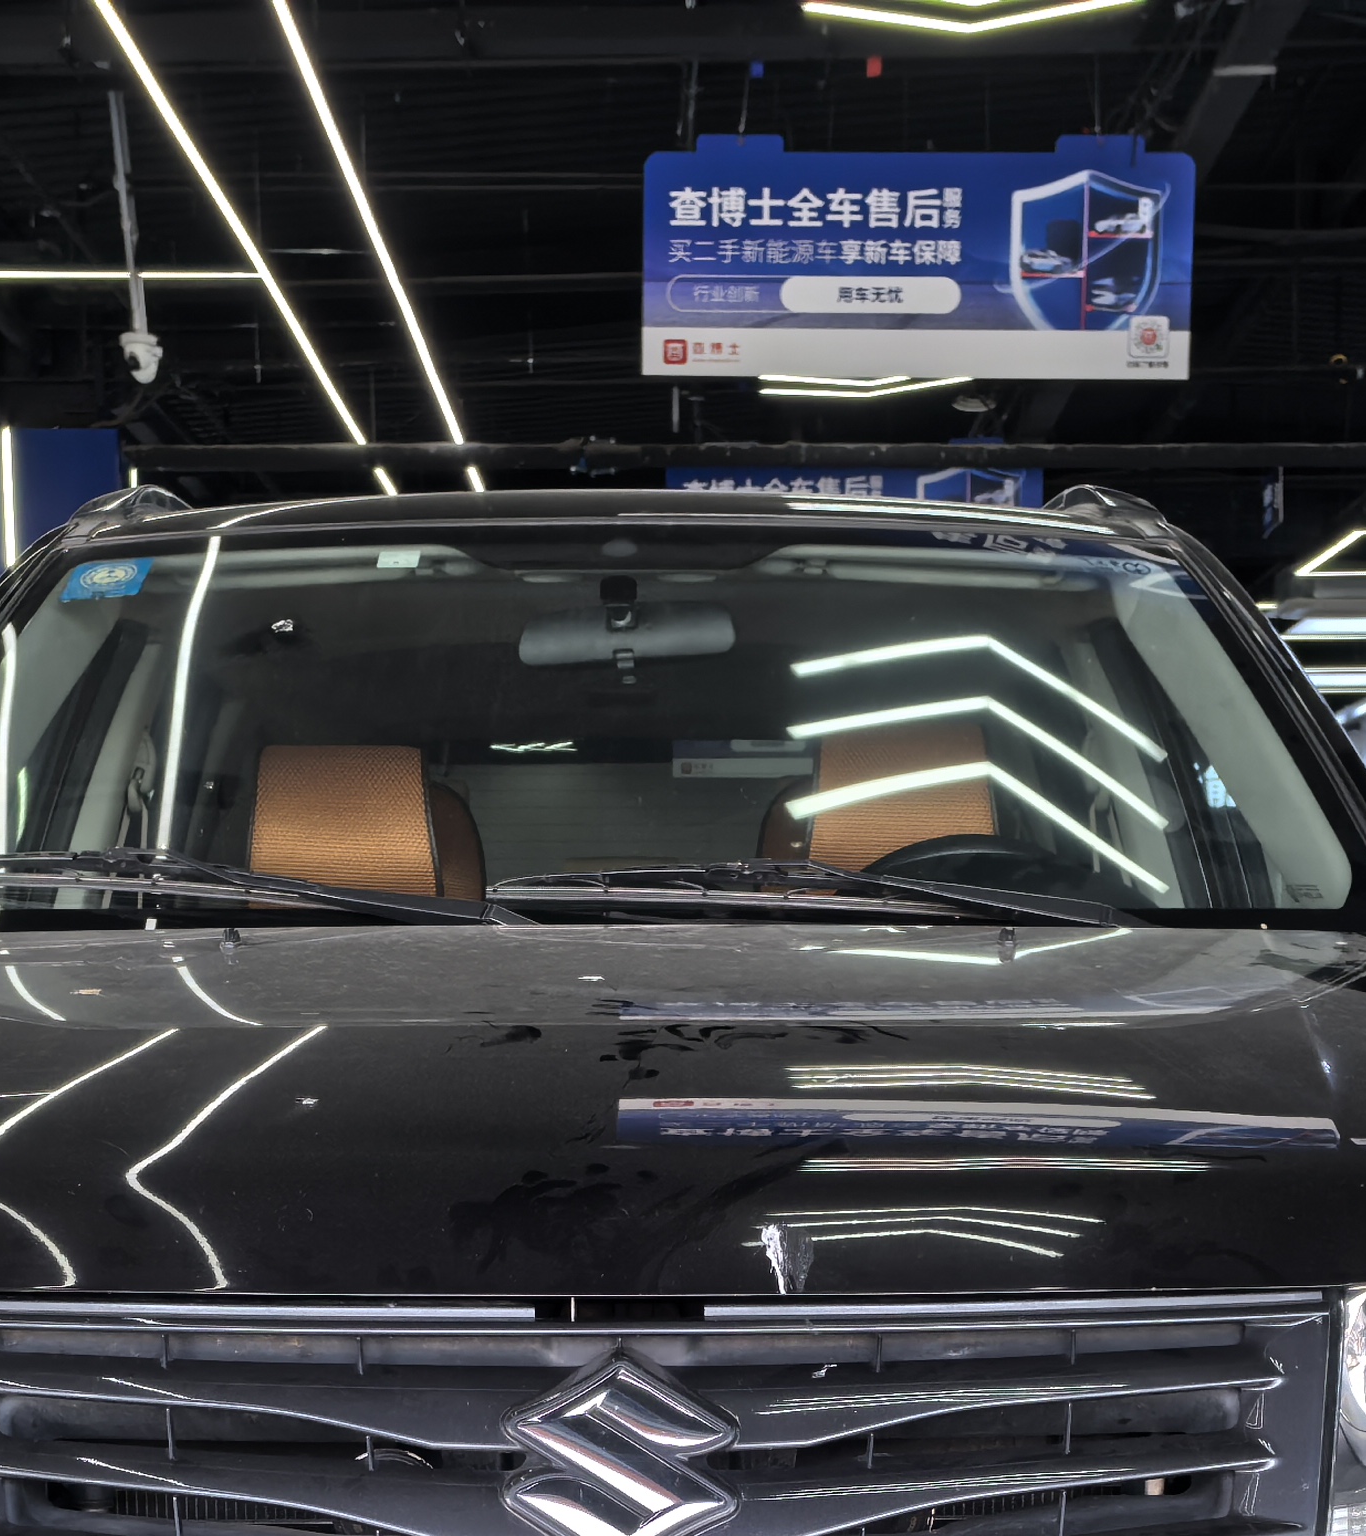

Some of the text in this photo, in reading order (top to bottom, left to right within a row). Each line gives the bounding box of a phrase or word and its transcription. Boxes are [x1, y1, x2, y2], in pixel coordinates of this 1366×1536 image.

[668, 238, 962, 265] 买二手新能源车享新车保障
[836, 286, 904, 304] 用车无忧
